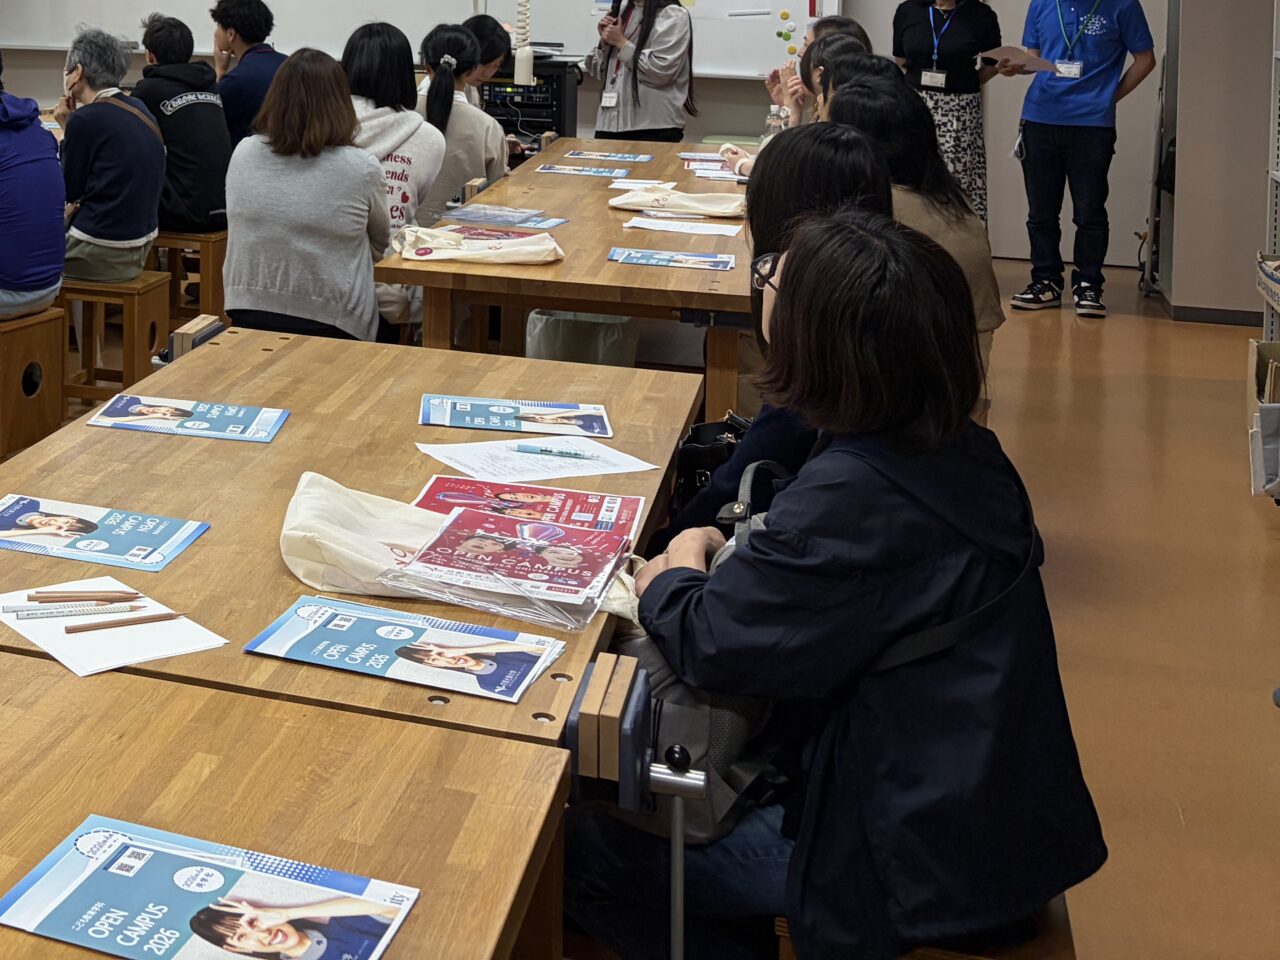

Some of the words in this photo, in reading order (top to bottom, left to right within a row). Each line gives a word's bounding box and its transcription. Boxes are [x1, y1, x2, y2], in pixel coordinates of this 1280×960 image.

[436, 547, 492, 562] OPEN
[501, 558, 593, 577] CAMPUS
[323, 643, 350, 660] OPEN
[345, 642, 378, 664] CAMPUS
[87, 907, 129, 938] OPEN
[115, 902, 169, 946] CAMPUS
[143, 927, 180, 956] 2026
